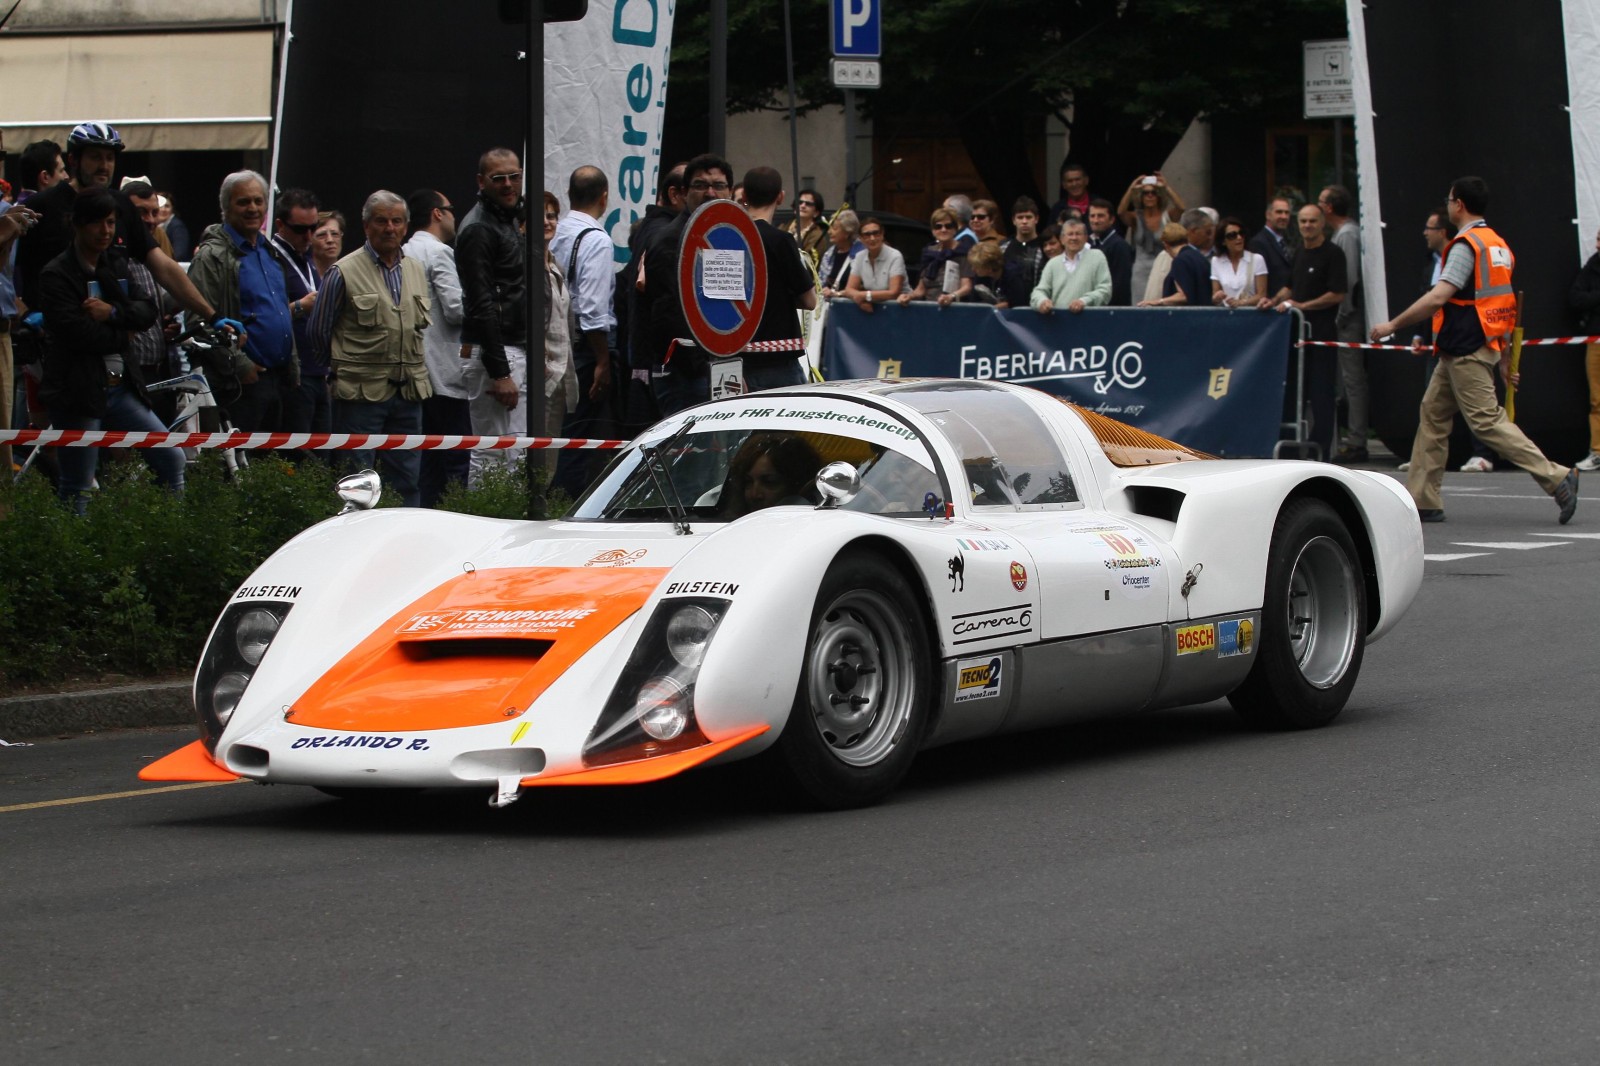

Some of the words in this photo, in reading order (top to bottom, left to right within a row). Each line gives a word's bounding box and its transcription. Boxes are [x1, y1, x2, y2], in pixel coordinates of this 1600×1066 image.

[843, 0, 871, 48] P
[1214, 374, 1225, 392] E
[682, 410, 736, 425] Dunlop
[739, 408, 775, 418] FHR
[775, 408, 920, 441] Langstreckencup
[235, 585, 302, 598] BILSTEIN
[666, 581, 740, 595] BILSTEIN
[456, 609, 597, 622] TECNOPISCINE
[953, 616, 1019, 635] Carrera
[1019, 610, 1032, 627] 6
[446, 620, 576, 629] INTERNATIONAL
[1177, 629, 1214, 650] BOSCH
[291, 736, 403, 749] ORLANDO
[405, 738, 430, 751] R.
